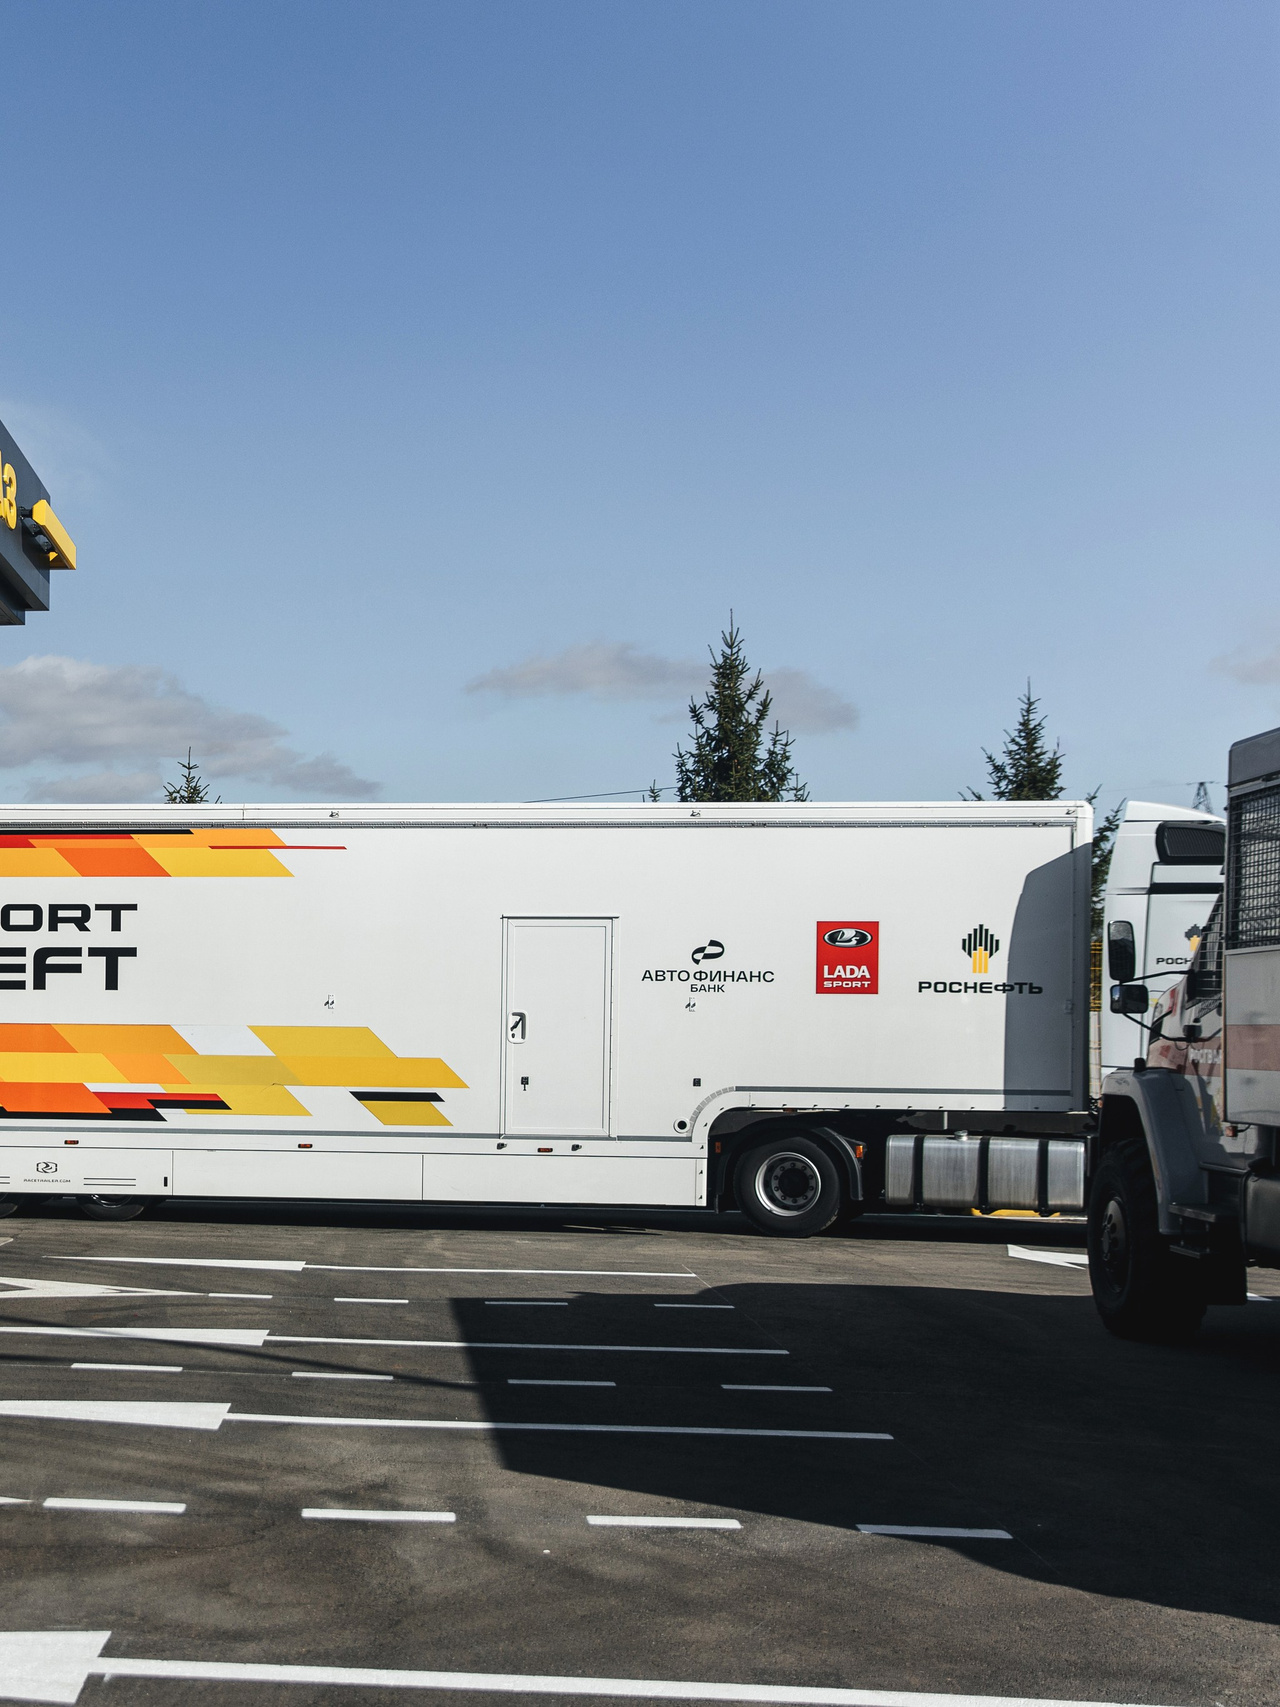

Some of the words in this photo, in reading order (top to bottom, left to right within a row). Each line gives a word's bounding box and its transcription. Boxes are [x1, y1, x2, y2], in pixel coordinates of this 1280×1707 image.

[823, 965, 871, 979] LADA
[690, 984, 725, 993] БАНК
[918, 981, 1043, 995] РОСНЕФТЬ
